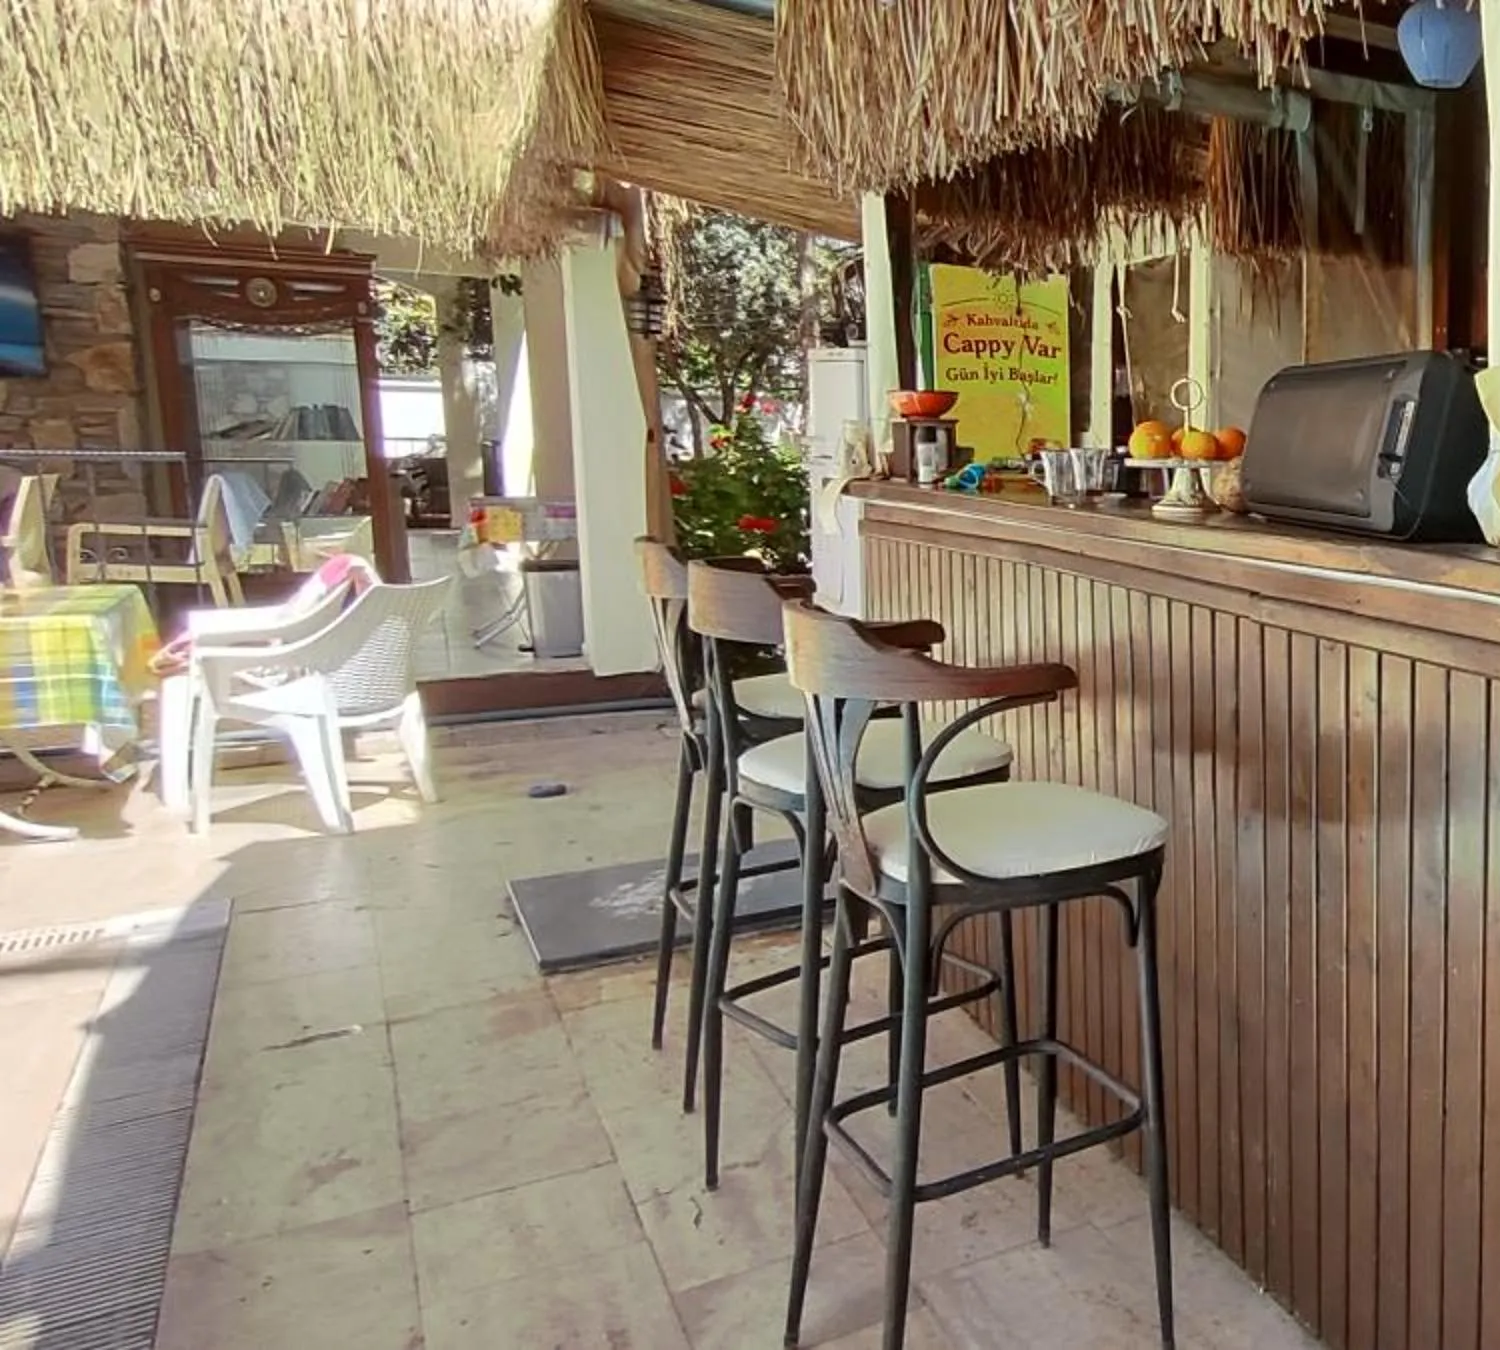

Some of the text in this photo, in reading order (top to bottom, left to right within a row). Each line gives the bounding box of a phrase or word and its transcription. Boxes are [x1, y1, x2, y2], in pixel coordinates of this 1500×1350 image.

[943, 332, 1062, 360] Cappy Var
[945, 362, 1058, 386] Gün İyi Başlar!
